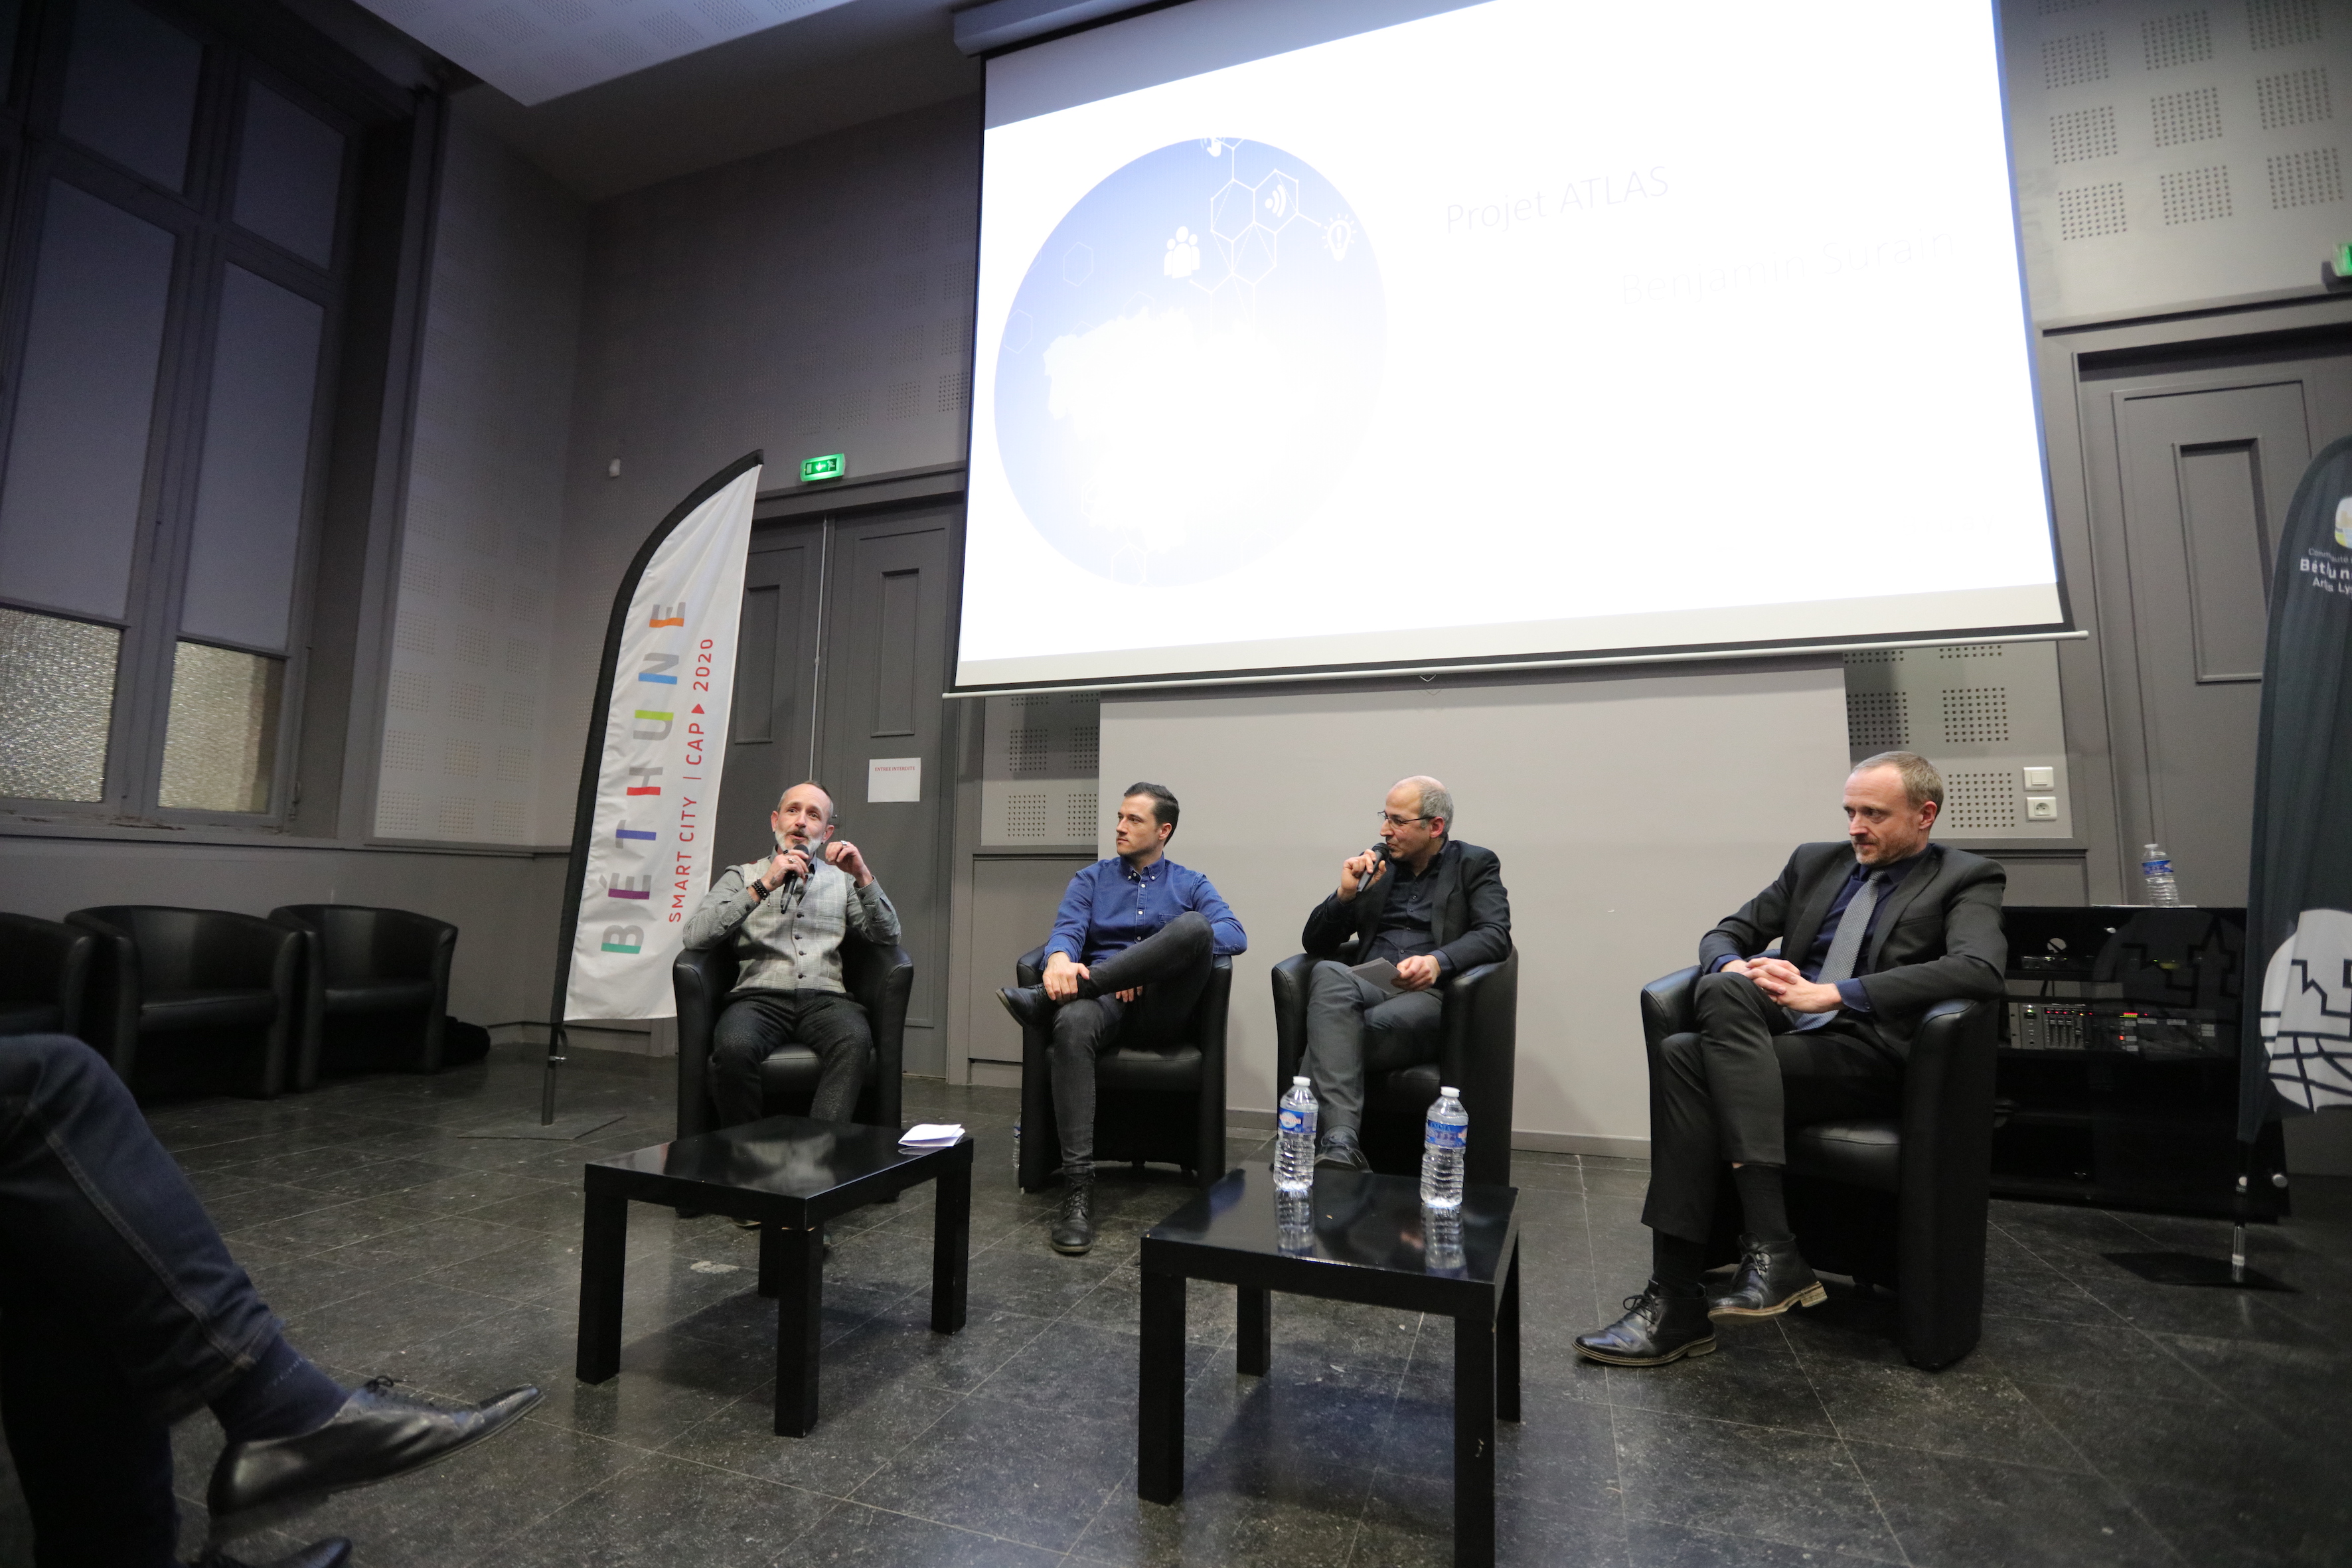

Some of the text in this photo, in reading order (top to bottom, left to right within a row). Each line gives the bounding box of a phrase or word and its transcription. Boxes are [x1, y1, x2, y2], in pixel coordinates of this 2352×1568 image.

[1447, 165, 1669, 234] Projet ATLAS
[1622, 252, 1805, 305] Benjamin
[599, 601, 686, 954] BÉTHUNE
[668, 639, 714, 922] SMART CITY CAP 2020
